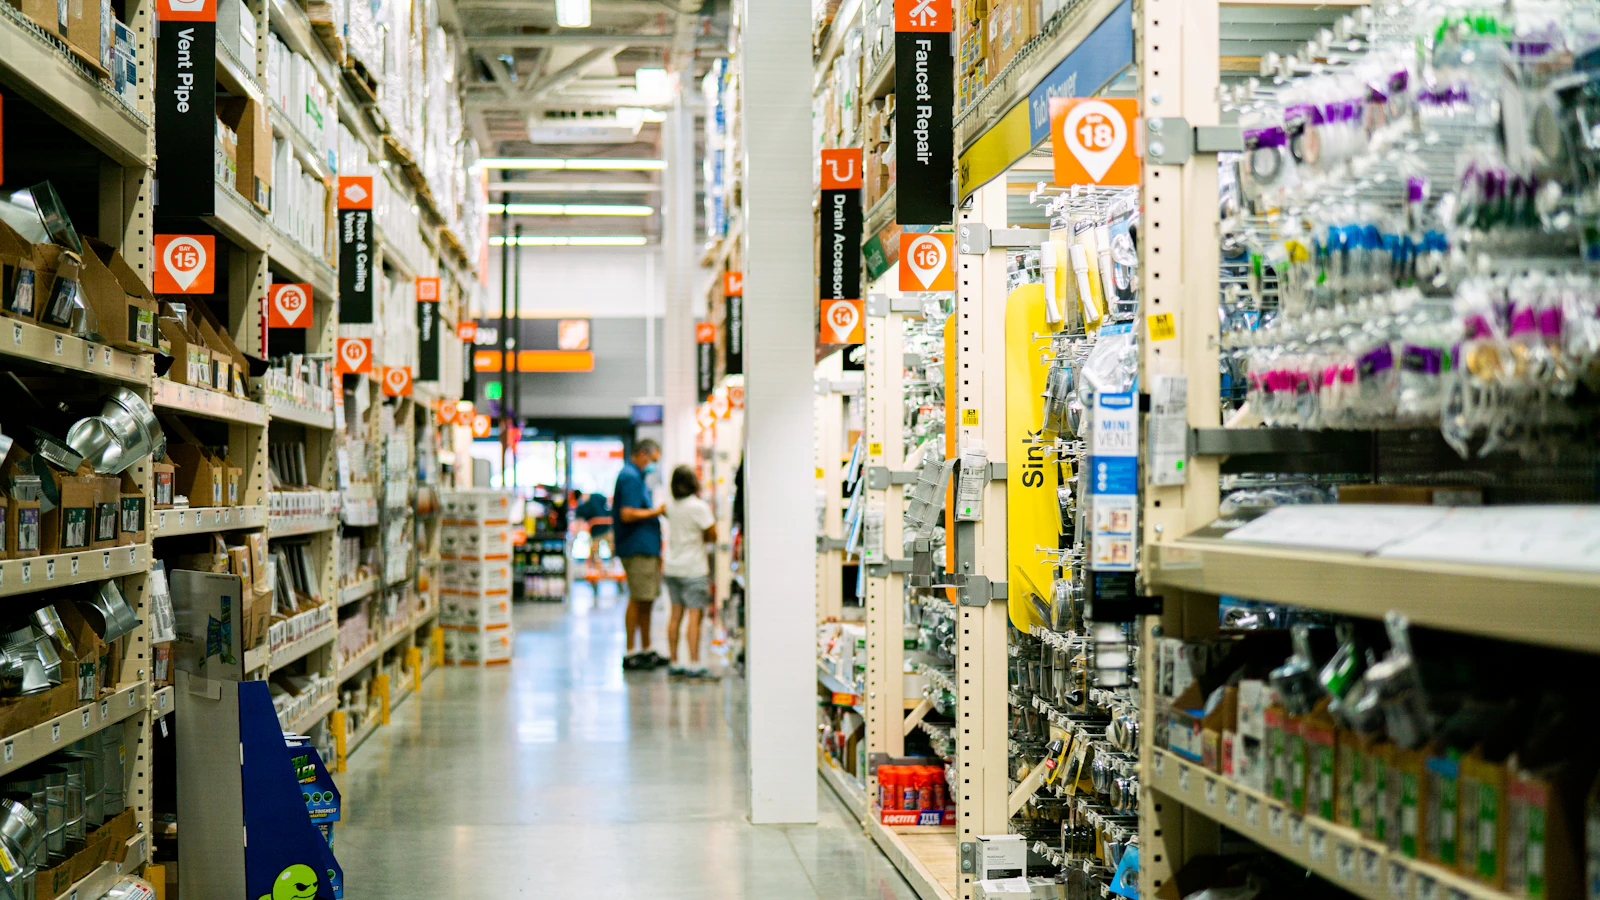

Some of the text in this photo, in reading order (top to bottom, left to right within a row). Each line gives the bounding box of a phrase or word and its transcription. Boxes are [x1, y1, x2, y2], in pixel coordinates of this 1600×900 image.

[174, 27, 194, 114] Vent Pipe
[913, 39, 933, 165] Faucet Repair
[1079, 123, 1113, 148] 18
[961, 159, 971, 189] Sink
[344, 211, 356, 244] Vents
[353, 211, 368, 292] Floor & Ceiling
[832, 193, 846, 299] Drain Accessori
[174, 252, 197, 268] 15
[916, 250, 938, 266] 16
[282, 296, 300, 309] 13
[834, 312, 851, 325] 14
[348, 347, 360, 357] 11
[1101, 419, 1130, 431] MINI
[1097, 432, 1133, 447] VENT
[1022, 429, 1043, 488] Sink
[883, 815, 917, 823] LOCTITE
[921, 813, 940, 821] TITE
